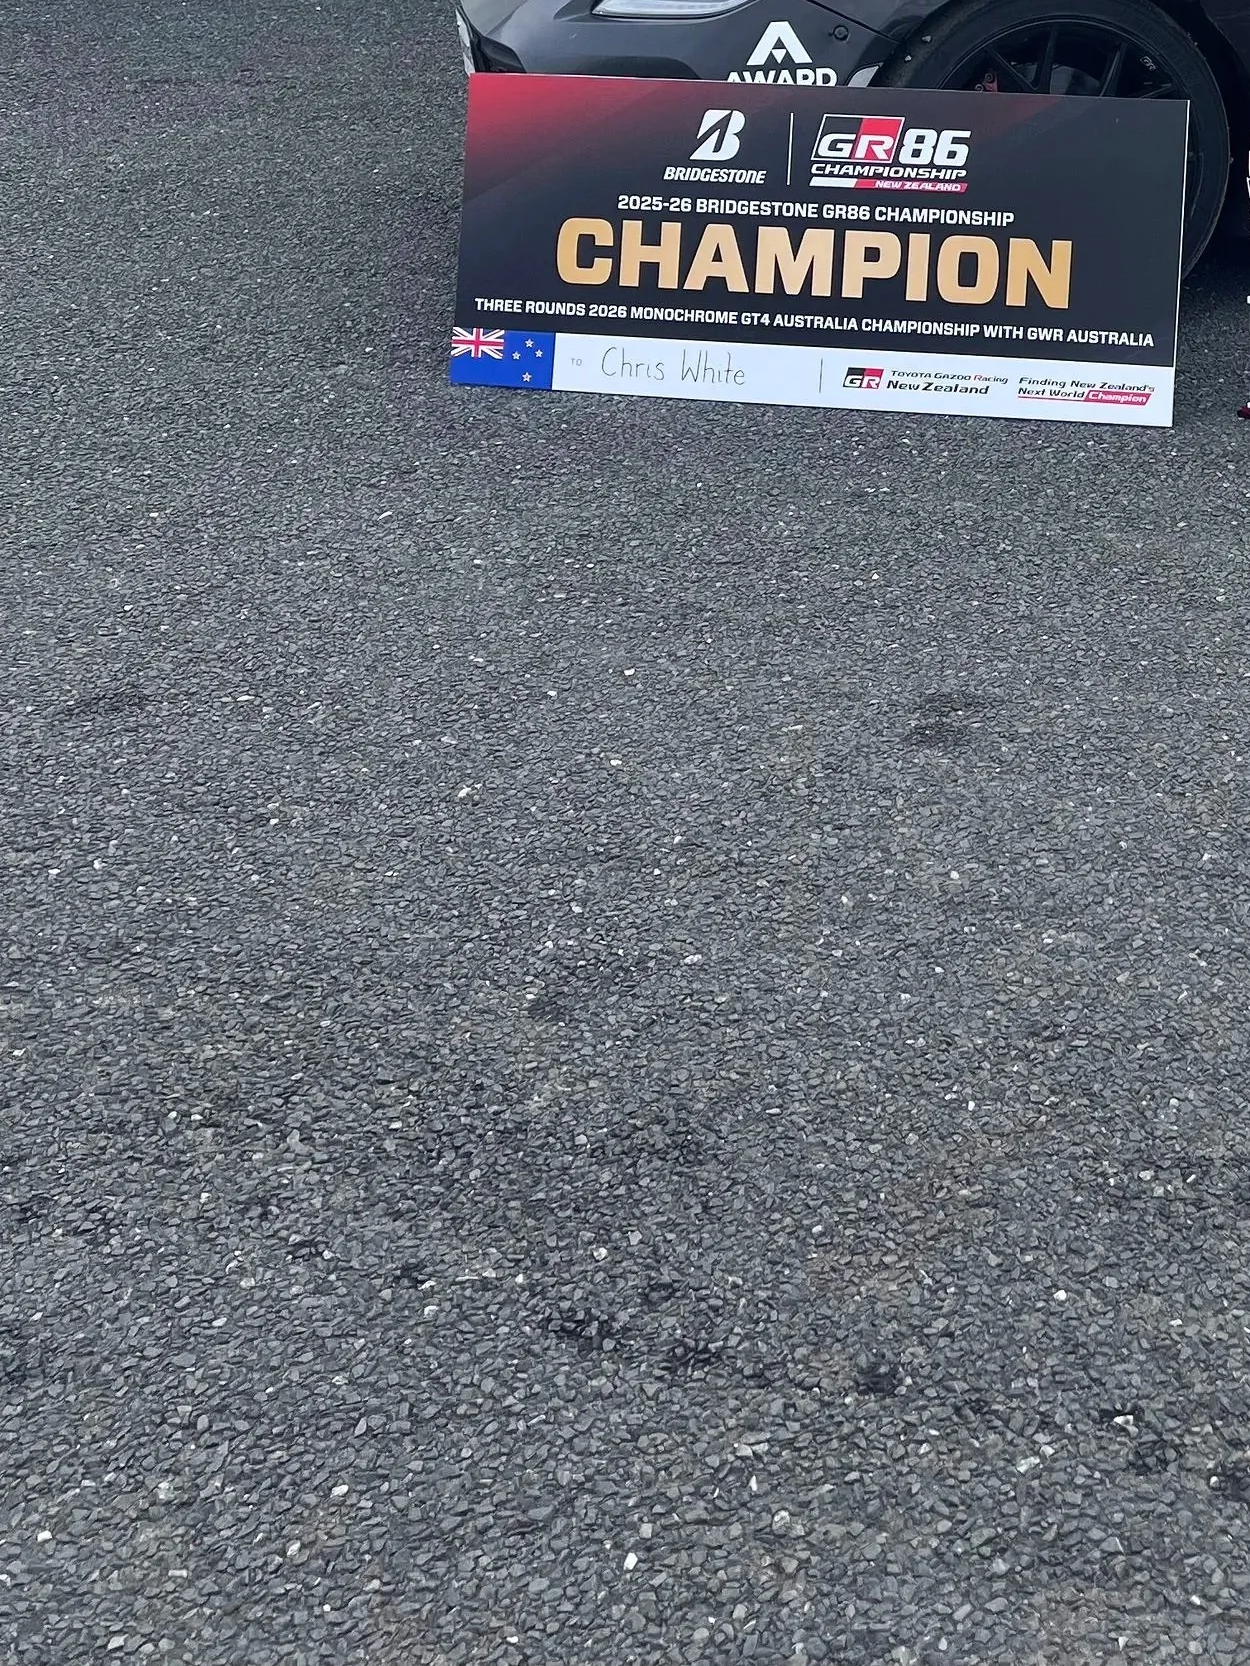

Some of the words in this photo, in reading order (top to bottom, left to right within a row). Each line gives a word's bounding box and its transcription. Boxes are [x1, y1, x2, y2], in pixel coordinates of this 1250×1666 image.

[663, 166, 767, 185] BRIDGESTONE
[811, 163, 967, 180] CHAMPIONSHIP
[875, 179, 902, 190] NEW
[903, 180, 961, 192] ZEALAND
[617, 194, 692, 213] 2025-26
[696, 199, 818, 219] BRIDGESTONE
[823, 204, 870, 222] GR86
[875, 206, 1014, 227] CHAMPIONSHIP
[556, 217, 1073, 309] CHAMPION
[475, 298, 523, 313] THREE
[525, 300, 585, 316] ROUNDS
[589, 304, 627, 318] 2026
[630, 306, 738, 325] MONOCHROME
[741, 311, 770, 326] GT4
[773, 313, 859, 331] AUSTRALIA
[861, 319, 980, 337] CHAMPIONSHIP
[983, 325, 1024, 340] WITH
[1027, 327, 1064, 342] GWR
[1067, 329, 1155, 347] AUSTRALIA
[570, 357, 583, 366] TO
[601, 346, 665, 381] Chris
[681, 348, 746, 385] White
[844, 375, 881, 389] GR
[891, 370, 932, 379] TOYOTA
[934, 371, 971, 381] GAZOO
[973, 374, 1009, 384] Racing
[1019, 377, 1066, 389] Finding
[1070, 379, 1097, 389] New
[1099, 381, 1155, 392] Zealand's
[887, 379, 920, 392] New
[922, 381, 990, 395] Zealand
[1018, 387, 1046, 397] Next
[1049, 388, 1085, 399] World
[1088, 391, 1148, 405] Champion
